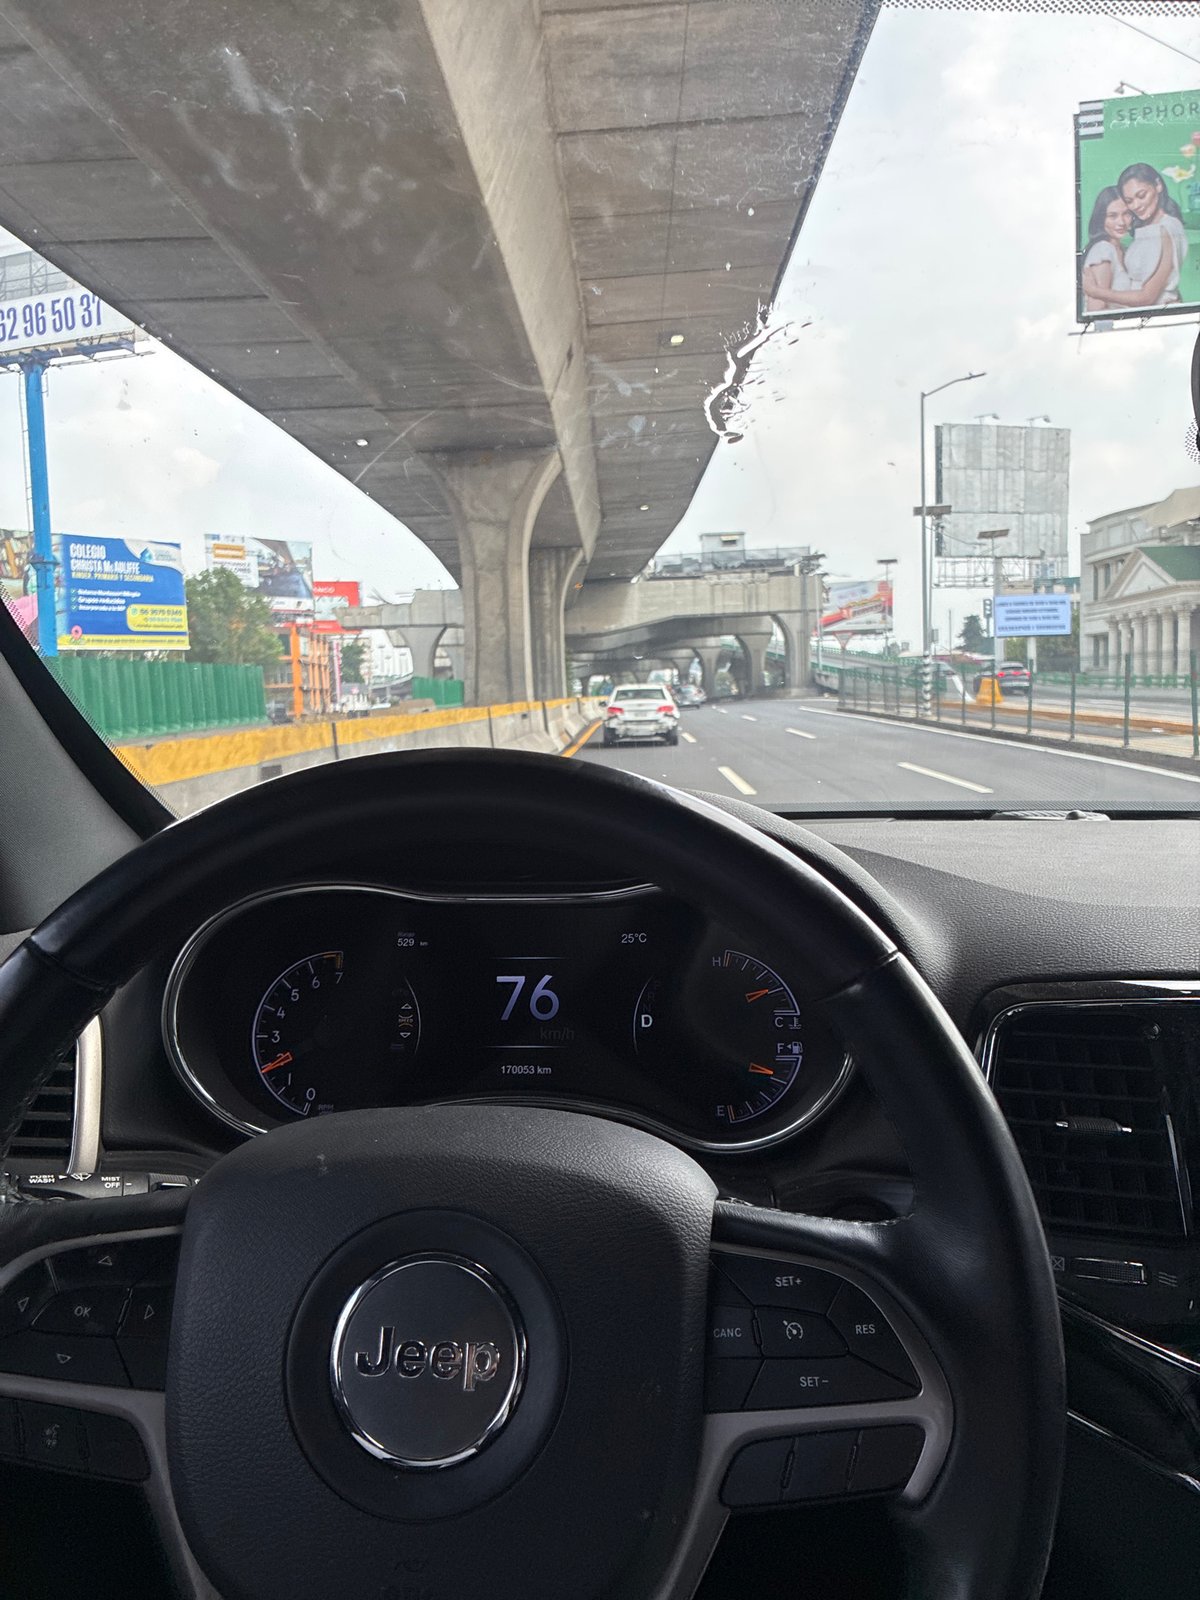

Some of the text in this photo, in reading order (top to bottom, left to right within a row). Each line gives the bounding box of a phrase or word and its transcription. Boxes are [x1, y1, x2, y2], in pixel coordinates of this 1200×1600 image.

[22, 302, 46, 337] 96
[51, 297, 76, 332] 50
[80, 293, 101, 327] 37
[70, 543, 106, 560] COLEGIO
[70, 559, 103, 573] CHRISTA
[397, 938, 415, 947] 529
[621, 932, 647, 943] 25°C
[712, 957, 721, 967] H
[311, 977, 321, 989] 6
[335, 972, 344, 984] 7
[291, 989, 300, 1001] 5
[496, 974, 560, 1021] 76
[276, 1007, 286, 1019] 4
[641, 1014, 653, 1028] D
[774, 1017, 784, 1028] C
[271, 1030, 281, 1043] 3
[540, 1026, 575, 1041] km/h
[777, 1043, 785, 1053] F
[501, 1065, 552, 1074] 170053 km
[288, 1073, 292, 1086] 1
[306, 1087, 316, 1101] 0
[717, 1105, 725, 1116] E
[775, 1275, 802, 1287] SET+
[73, 1305, 92, 1318] OK
[713, 1327, 742, 1338] CANC
[855, 1323, 876, 1335] RES
[355, 1325, 500, 1391] Jeep
[799, 1376, 829, 1388] SET-
